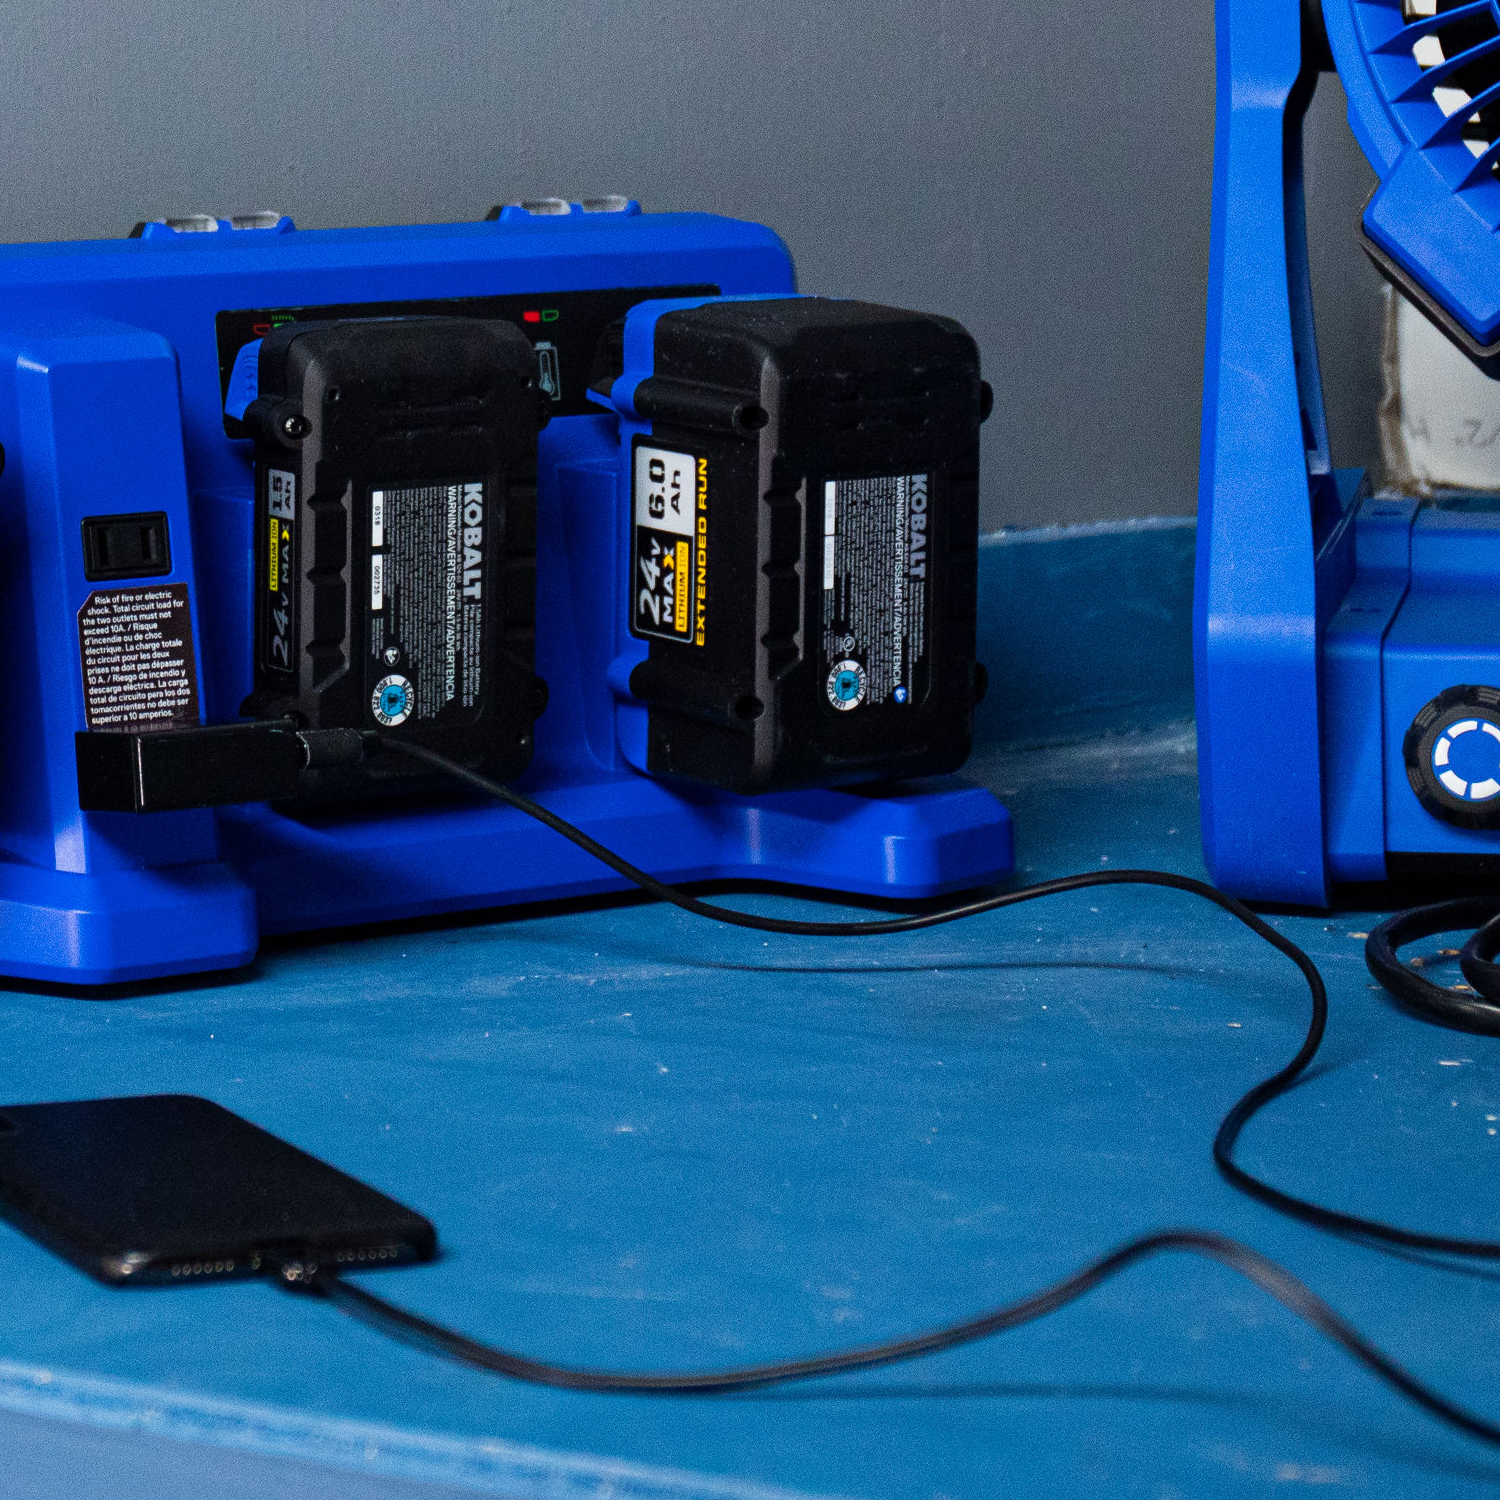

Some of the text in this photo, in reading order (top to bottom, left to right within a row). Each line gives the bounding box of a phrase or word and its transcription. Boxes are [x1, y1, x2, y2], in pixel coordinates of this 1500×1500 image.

[272, 475, 282, 512] 1.5
[284, 480, 291, 510] Ah
[648, 458, 666, 520] 6.0
[670, 468, 680, 516] Ah
[910, 474, 928, 578] KOBALT
[463, 483, 482, 600] KOBALT
[696, 458, 708, 646] EXTENDED RUN
[282, 524, 290, 584] MAX
[640, 536, 675, 625] 24v MAX
[892, 476, 904, 687] WARNING/AVERTISSEMENT/ADVERTENCIA
[95, 596, 110, 605] Risk
[121, 594, 134, 602] fire
[135, 593, 143, 601] or
[145, 591, 172, 599] electric
[446, 486, 456, 700] WARNING/AVERTISSEMENT/ADVERTENCIA
[677, 571, 686, 628] LITHIUM
[87, 600, 184, 615] shock. Total circuit load for
[97, 616, 110, 624] two
[112, 614, 138, 623] outlets
[140, 612, 158, 621] must
[84, 626, 109, 635] exceed
[133, 622, 158, 632] Risque
[85, 635, 121, 645] d'incendie
[134, 633, 143, 641] de
[126, 644, 134, 652] La
[136, 642, 160, 652] charge
[162, 639, 182, 647] totale
[86, 657, 95, 665] du
[97, 655, 120, 664] circuit
[122, 654, 138, 663] pour
[87, 666, 109, 676] prises
[121, 662, 136, 671] doit
[138, 662, 150, 671] pas
[88, 676, 95, 685] 10
[113, 673, 137, 683] Riesgo
[139, 671, 147, 680] de
[149, 669, 179, 679] incendio
[89, 685, 121, 695] descarga
[158, 680, 166, 688] La
[168, 678, 188, 688] carga
[90, 695, 106, 704] total
[108, 695, 117, 703] de
[119, 692, 146, 701] circuito
[148, 690, 163, 700] para
[165, 689, 175, 697] los
[91, 703, 145, 715] tomacorrientes
[158, 698, 175, 707] debe
[401, 680, 414, 718] RECYCLE
[92, 713, 121, 724] superior
[129, 712, 137, 720] 10
[139, 709, 174, 720] amperios.
